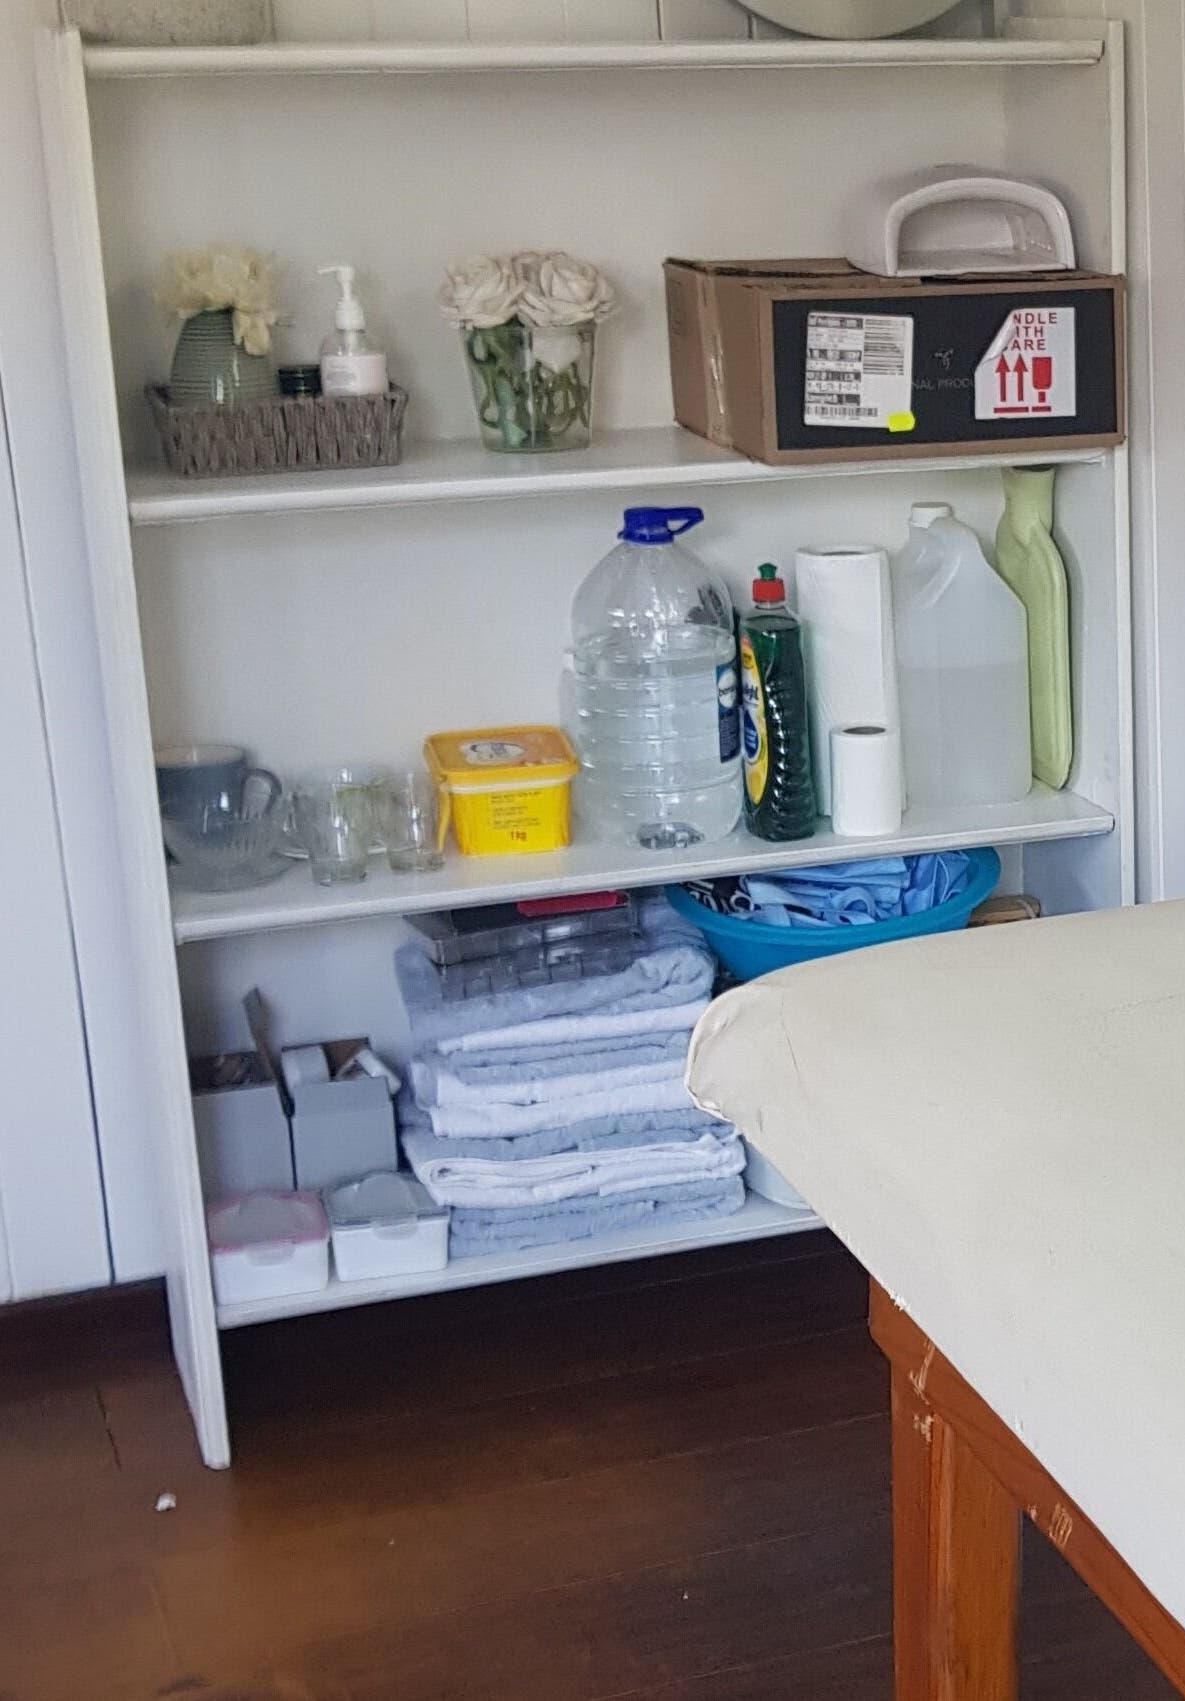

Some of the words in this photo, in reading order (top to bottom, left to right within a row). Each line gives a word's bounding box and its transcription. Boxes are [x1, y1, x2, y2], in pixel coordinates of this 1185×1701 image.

[1013, 313, 1058, 325] NDLE
[1015, 326, 1044, 338] ITH
[1011, 339, 1047, 351] ARE
